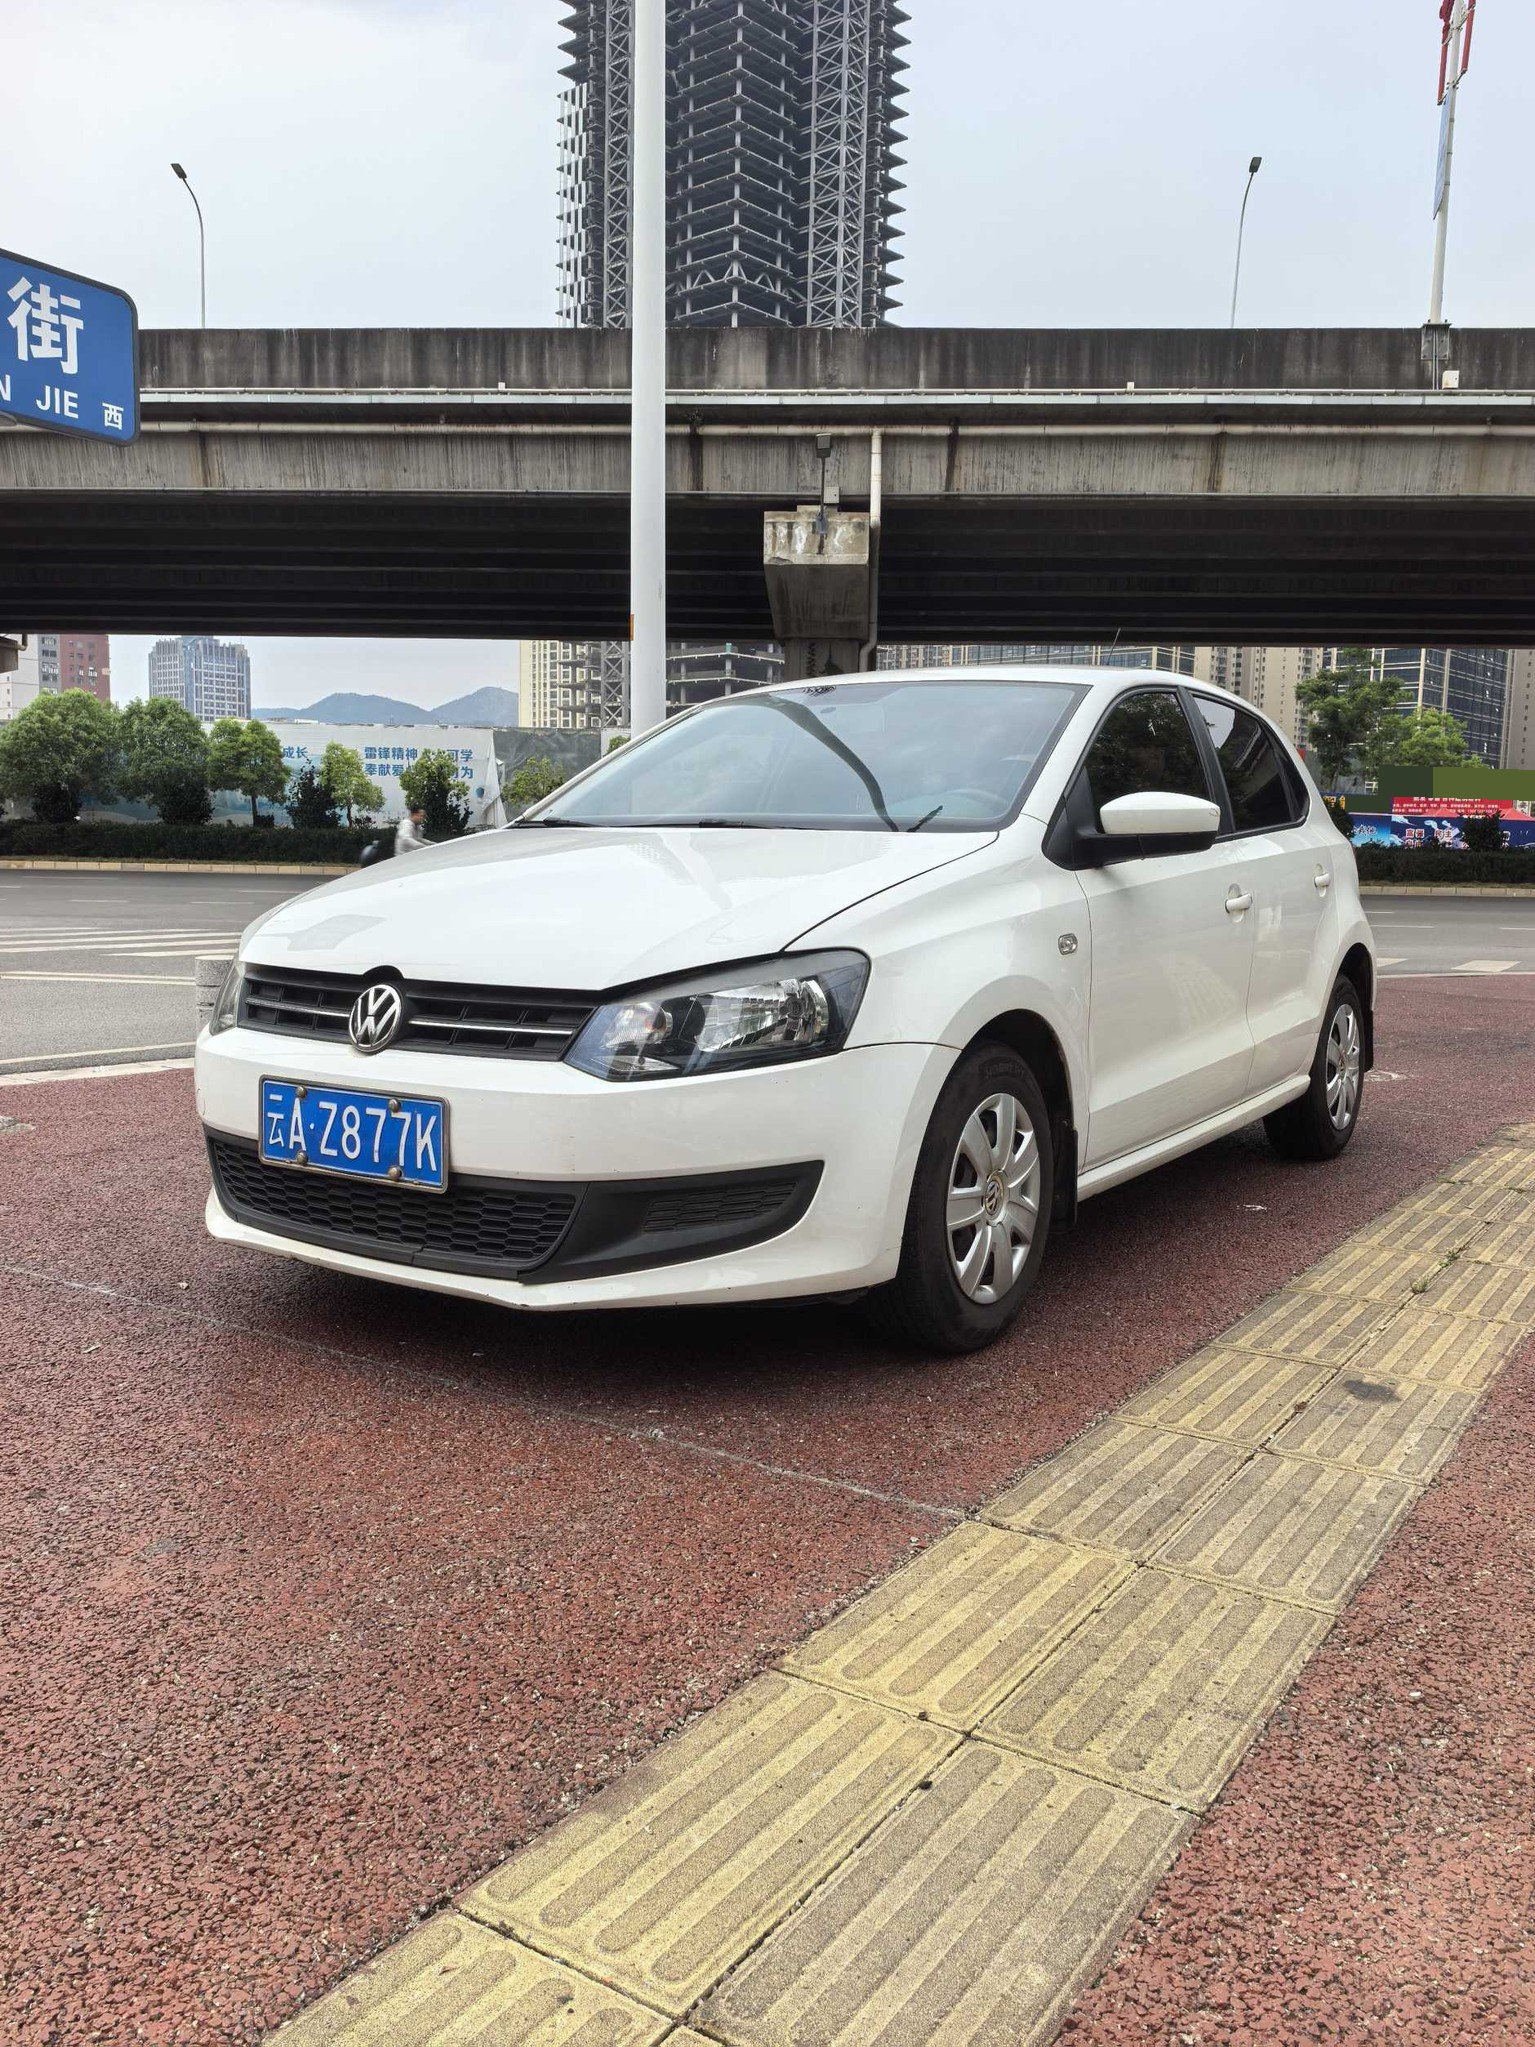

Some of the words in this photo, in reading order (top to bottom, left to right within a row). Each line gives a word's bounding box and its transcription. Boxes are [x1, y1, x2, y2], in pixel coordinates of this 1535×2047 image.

[7, 276, 84, 375] 街
[36, 385, 78, 419] JIE
[102, 402, 124, 431] 西
